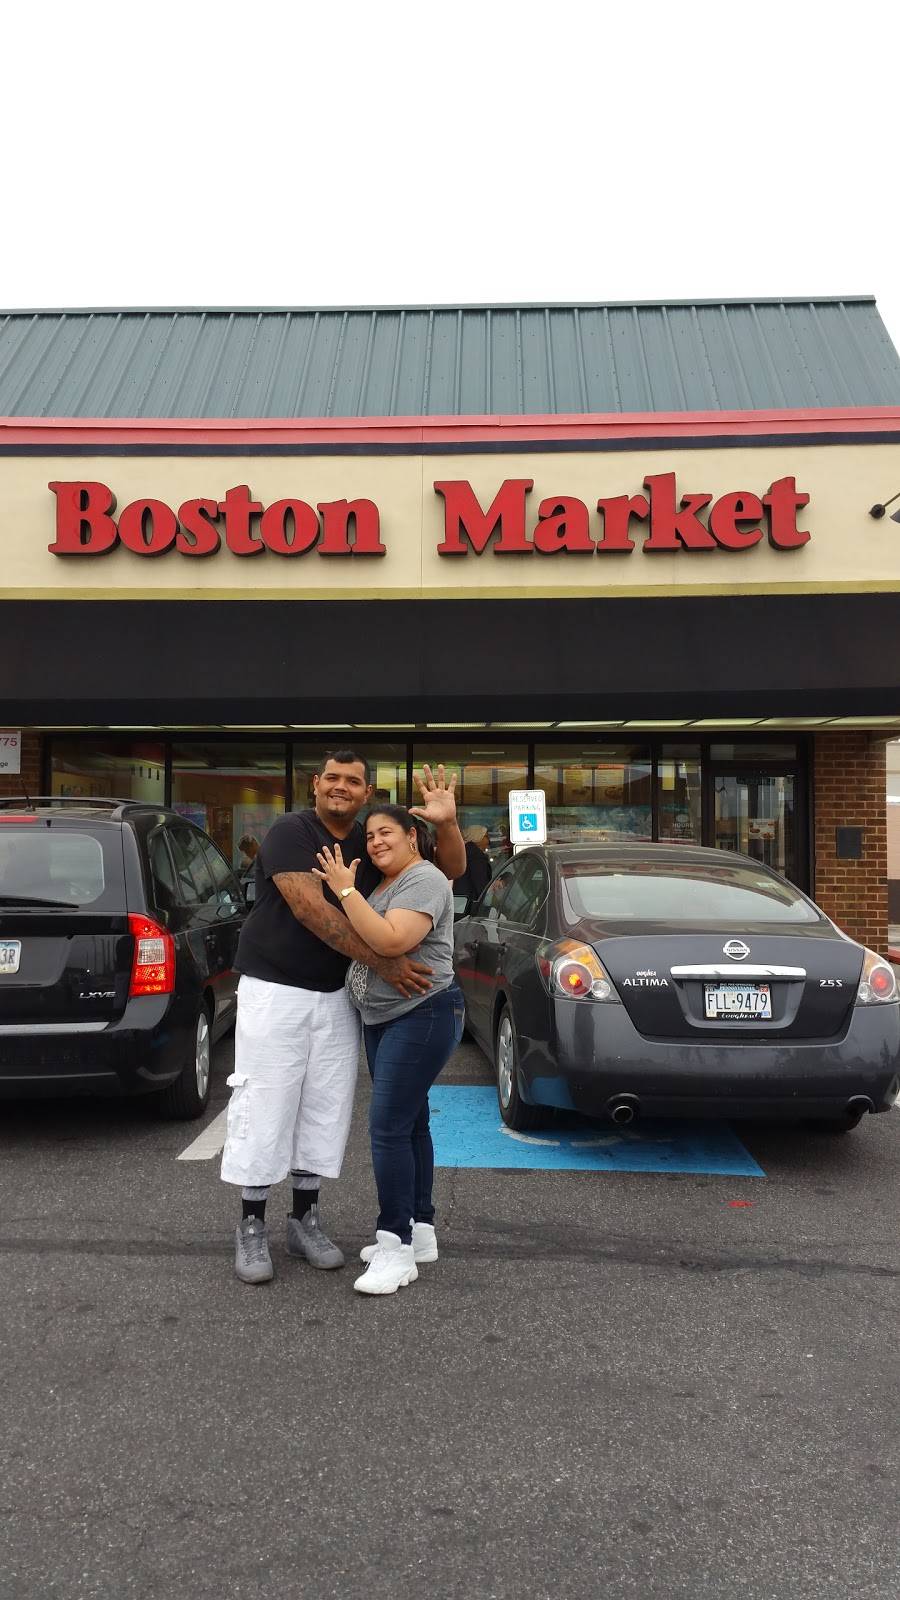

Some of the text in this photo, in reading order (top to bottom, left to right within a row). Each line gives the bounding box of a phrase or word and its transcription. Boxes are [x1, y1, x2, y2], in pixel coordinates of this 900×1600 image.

[48, 472, 811, 557] Boston Market
[0, 737, 17, 747] 75
[512, 795, 542, 803] RESERVED
[623, 978, 668, 987] ALTIMA
